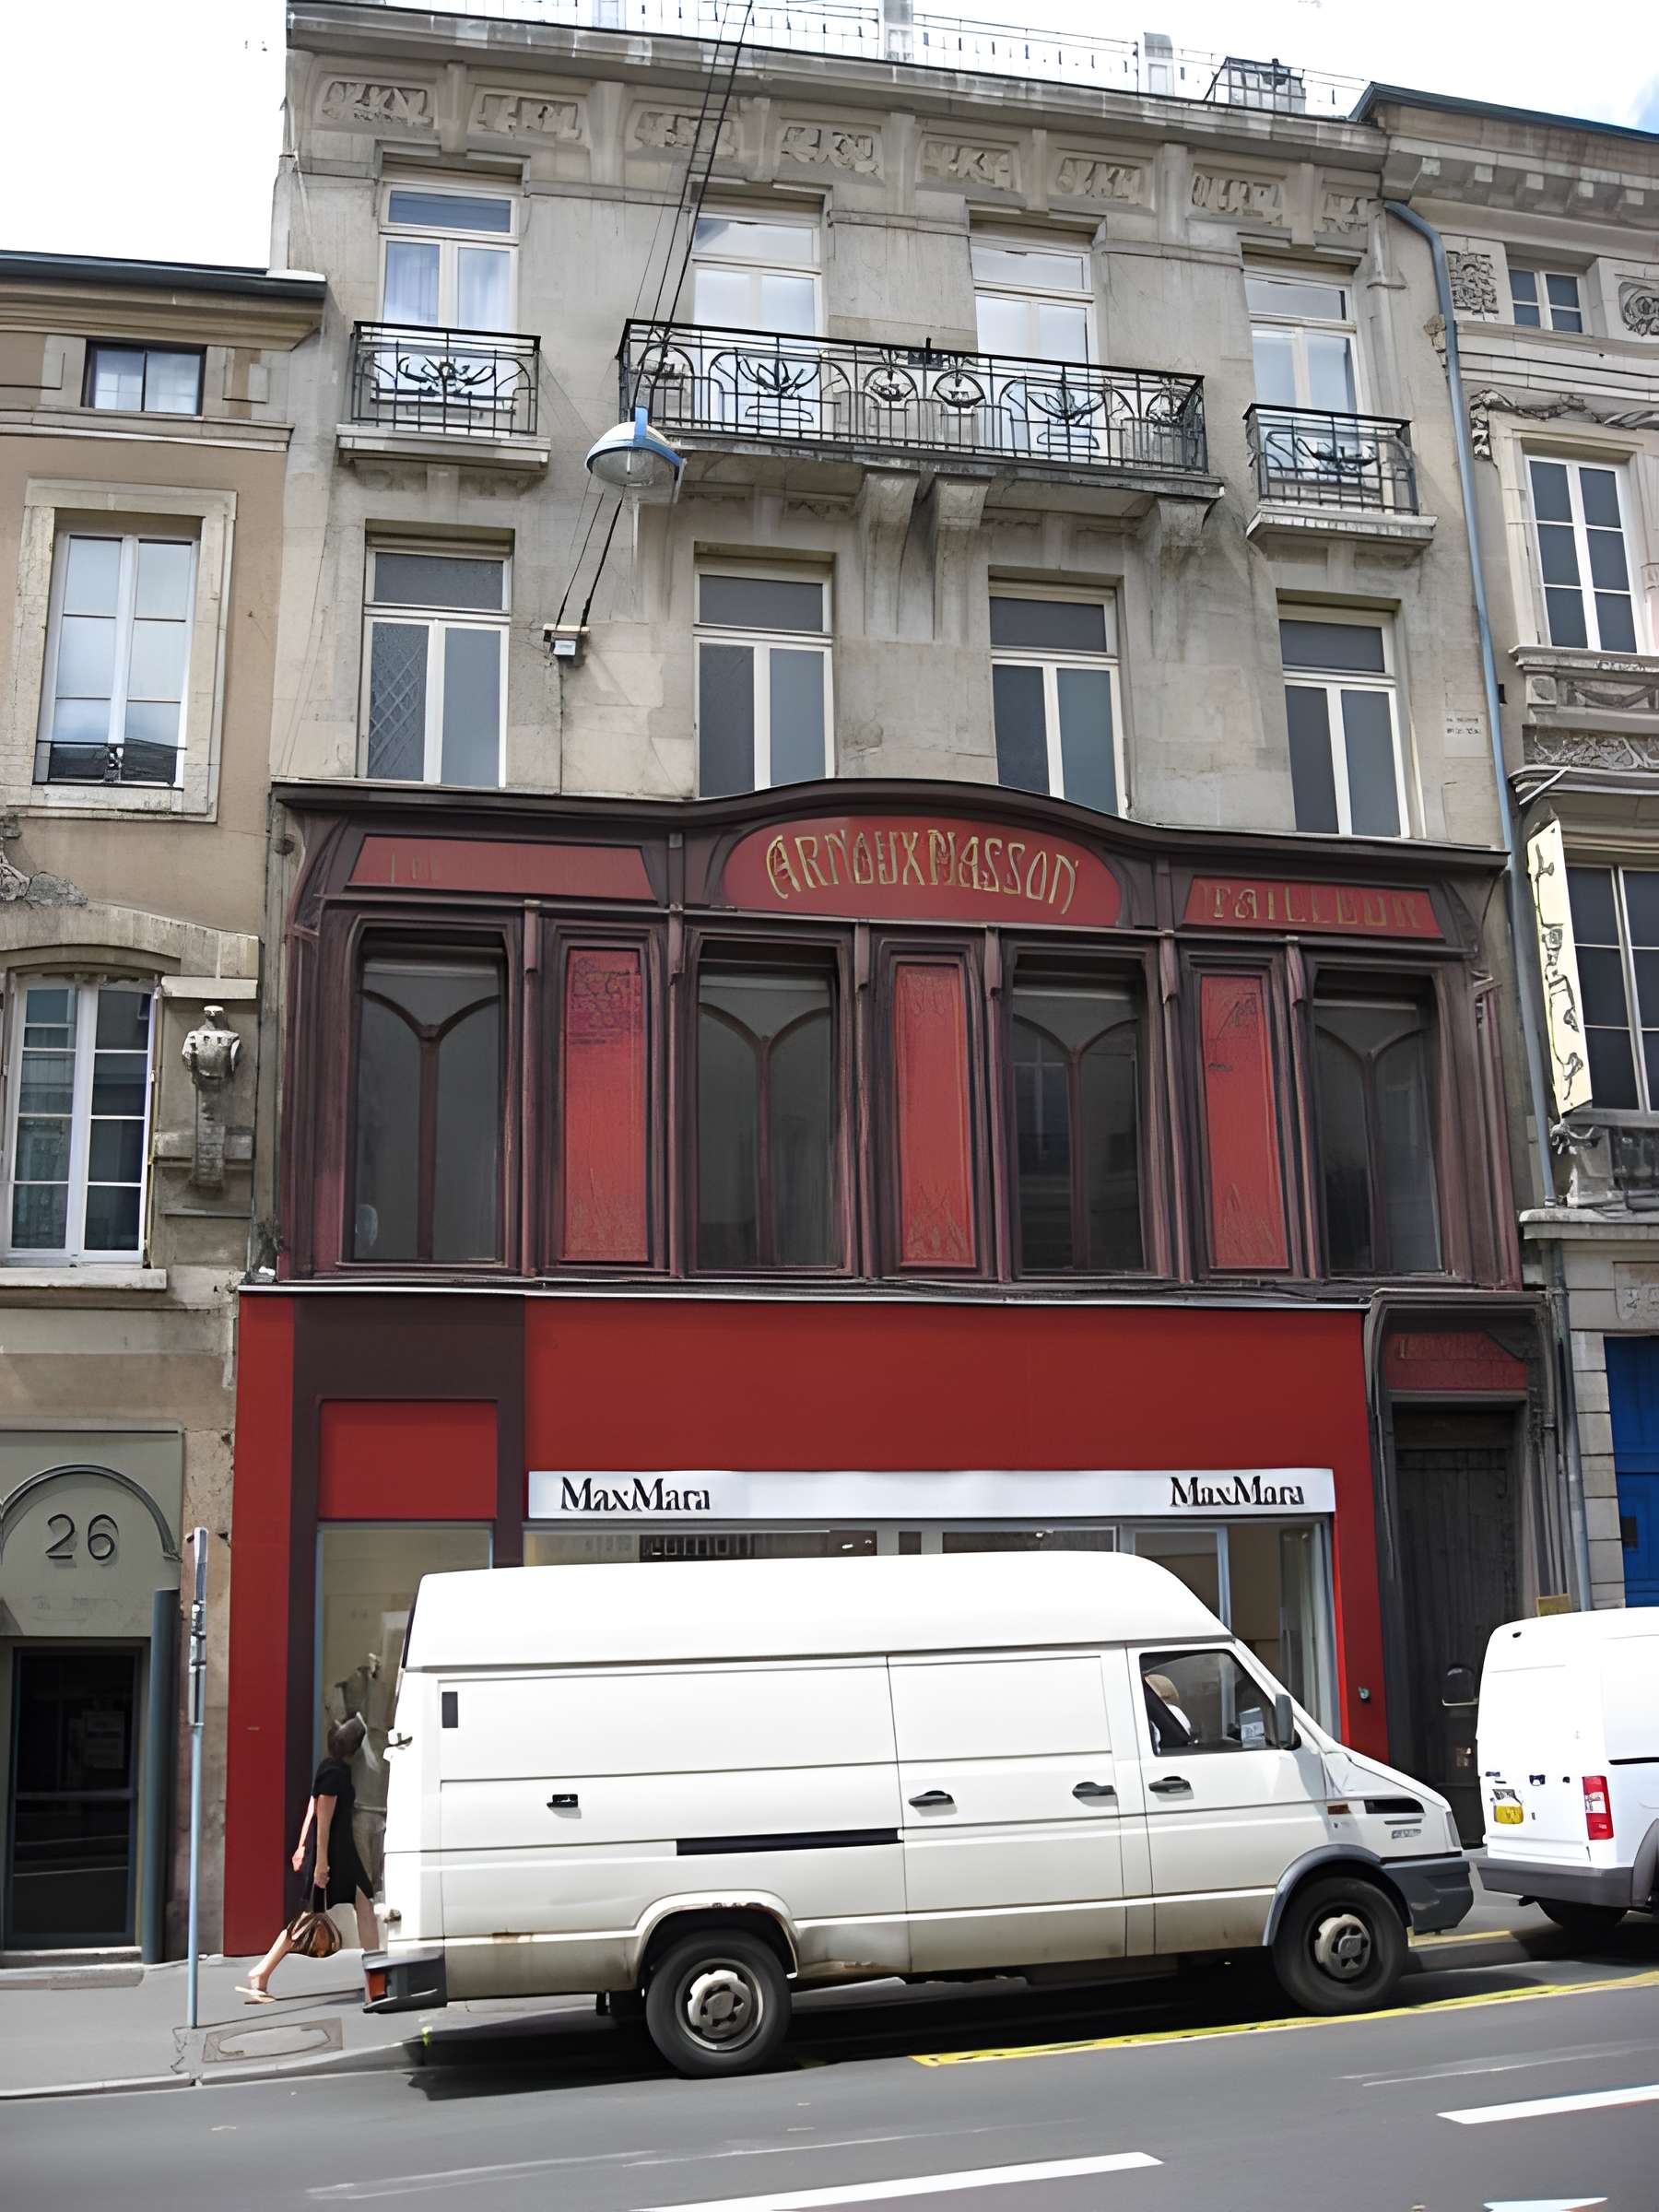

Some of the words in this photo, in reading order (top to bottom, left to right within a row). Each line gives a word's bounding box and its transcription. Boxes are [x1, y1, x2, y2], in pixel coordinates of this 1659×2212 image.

[560, 1477, 711, 1511] MaxMara
[1169, 1475, 1305, 1507] MaxMara
[45, 1513, 119, 1562] 26
